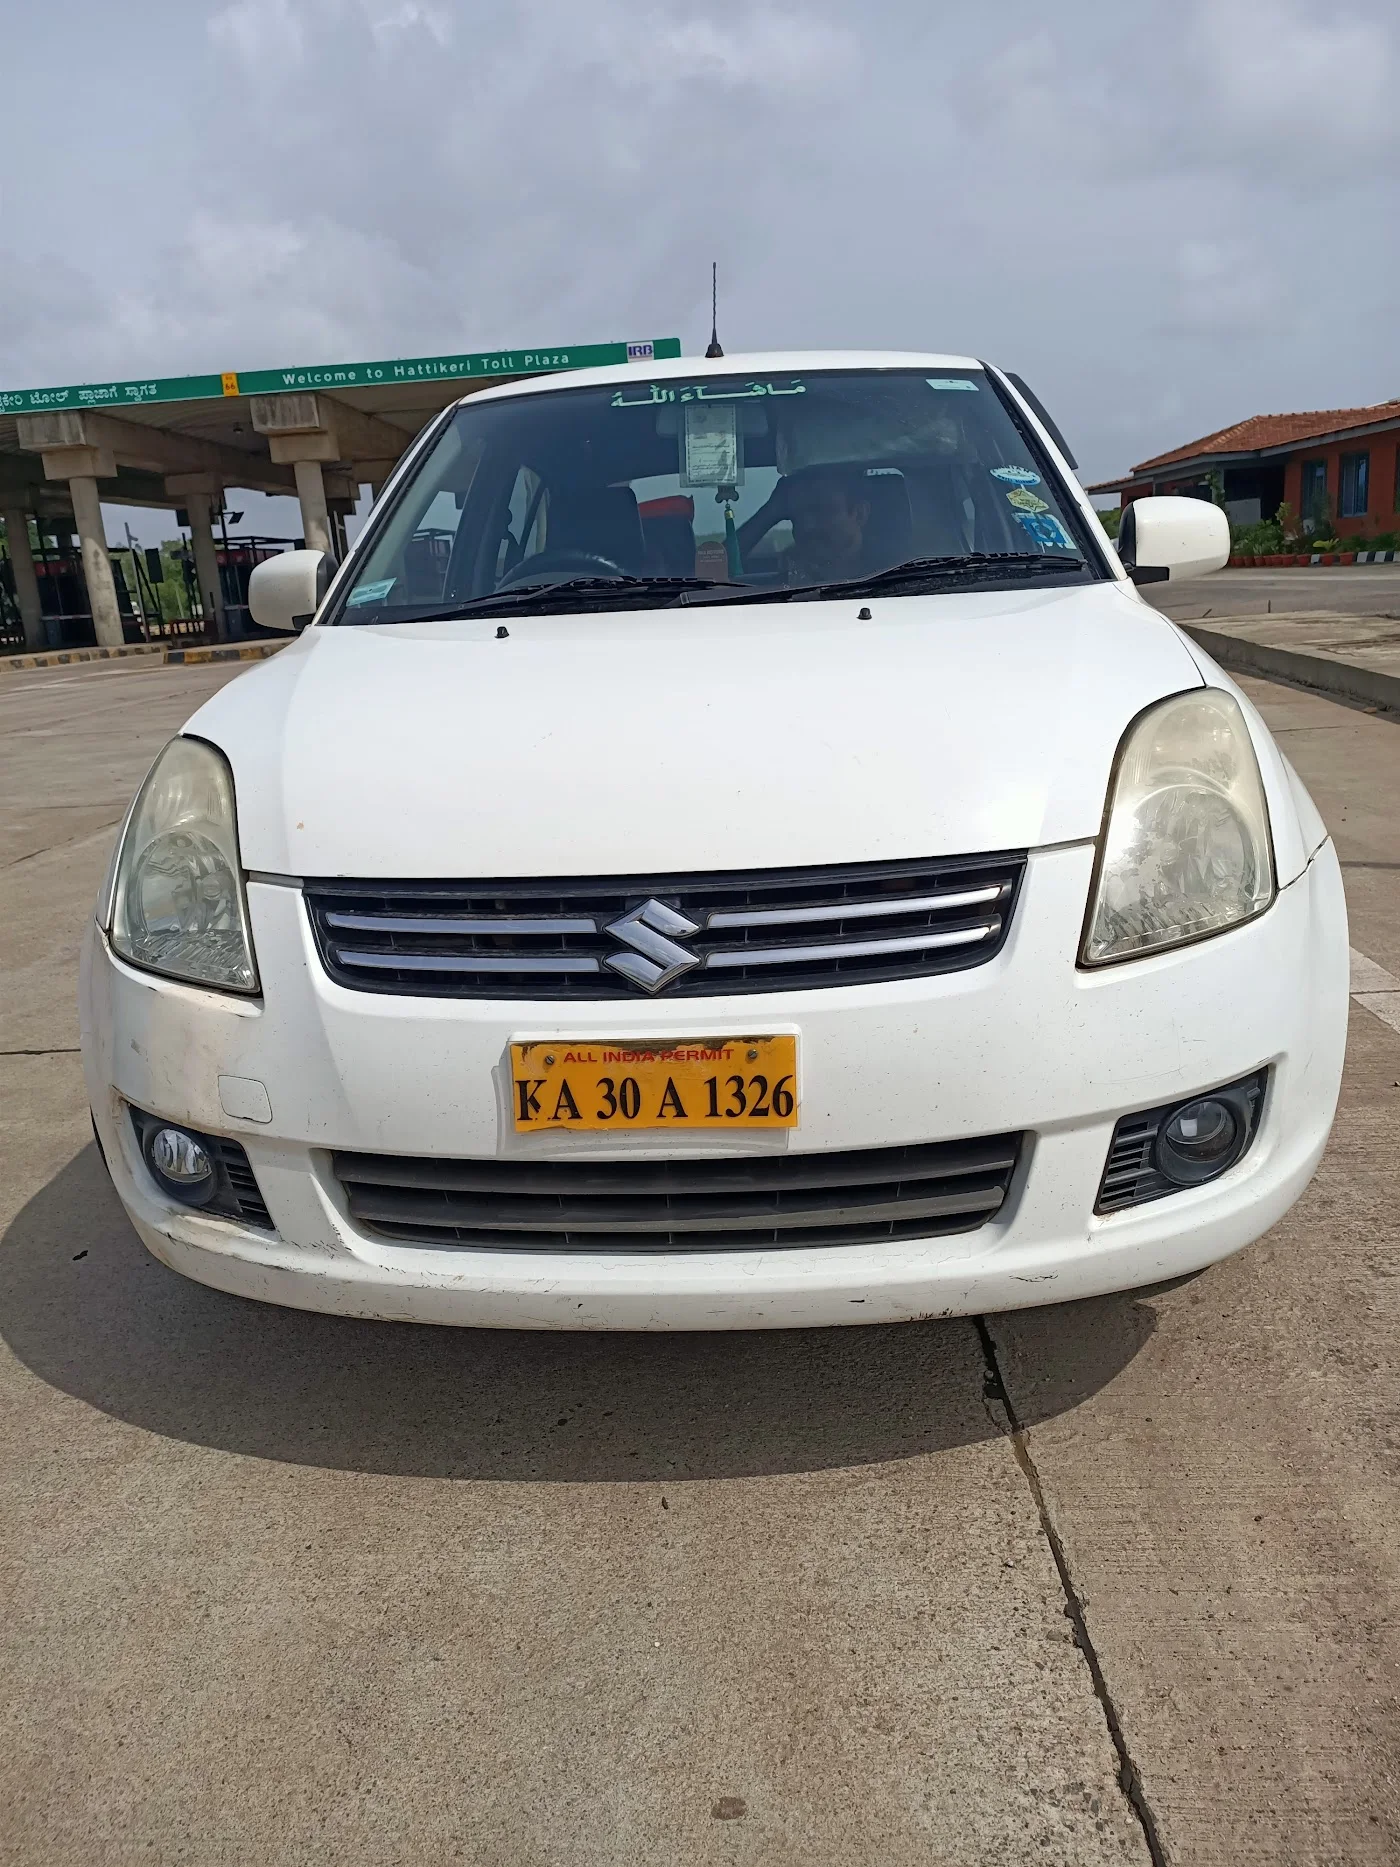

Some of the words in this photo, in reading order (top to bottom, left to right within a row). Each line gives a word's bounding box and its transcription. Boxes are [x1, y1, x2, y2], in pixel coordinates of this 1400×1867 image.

[628, 344, 652, 356] IRB
[282, 371, 356, 385] Welcome
[366, 368, 383, 379] to
[394, 360, 471, 377] Hattikeri
[481, 357, 513, 370] Toll
[525, 354, 569, 366] Plaza
[225, 383, 236, 391] 66
[564, 1052, 598, 1063] ALL
[603, 1050, 655, 1063] INDIA
[660, 1049, 734, 1061] PERMIT
[515, 1078, 583, 1121] KA
[596, 1077, 641, 1119] 30
[656, 1076, 688, 1118] A
[704, 1074, 794, 1118] 1326
